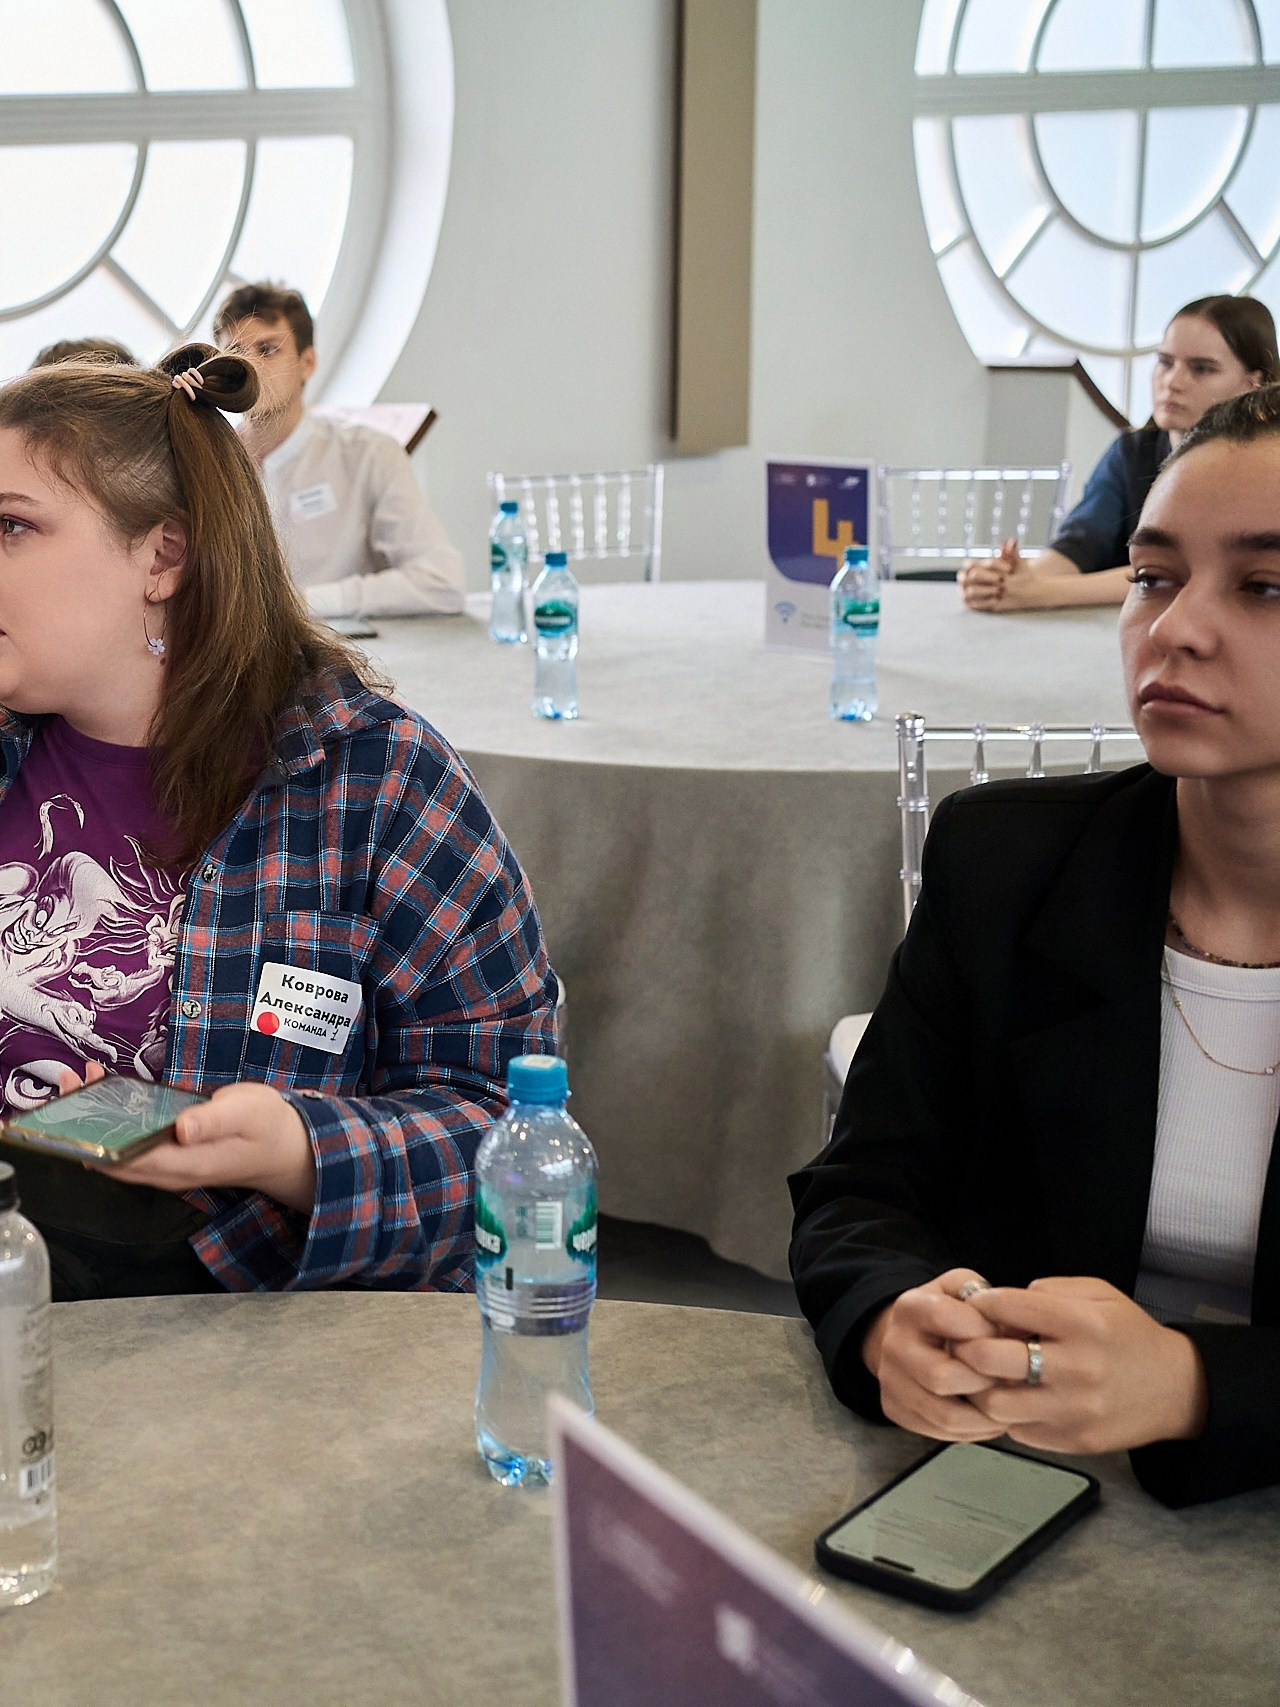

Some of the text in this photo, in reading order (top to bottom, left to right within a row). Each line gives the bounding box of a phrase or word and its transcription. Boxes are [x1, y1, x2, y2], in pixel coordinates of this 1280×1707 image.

[812, 498, 860, 574] 4
[281, 973, 350, 1004] Коврова
[259, 991, 352, 1029] Александра
[283, 1017, 328, 1038] КОМАНДА
